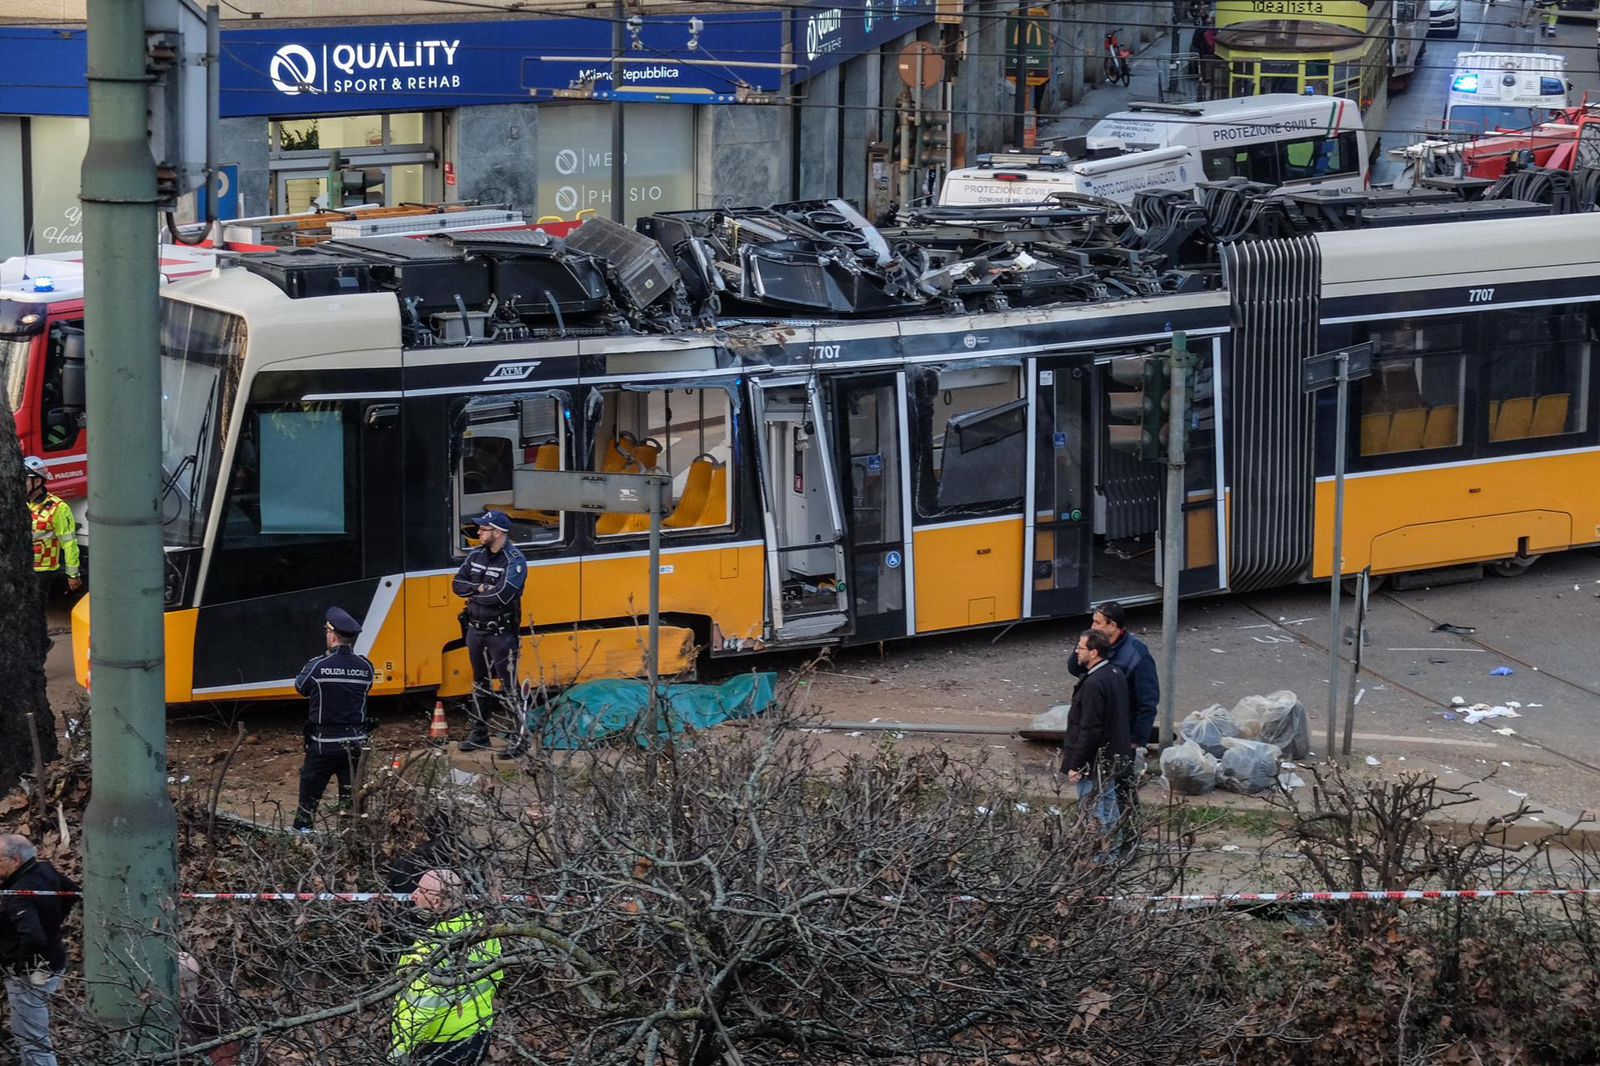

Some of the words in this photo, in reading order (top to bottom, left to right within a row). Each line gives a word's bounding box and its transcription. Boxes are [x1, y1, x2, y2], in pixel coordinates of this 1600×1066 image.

[332, 39, 461, 75] QUALITY
[333, 78, 387, 93] SPORT
[392, 78, 402, 90] &
[408, 75, 461, 89] REHAB
[1213, 122, 1282, 141] PROTEZIONE
[1284, 118, 1317, 133] CIVILE
[963, 184, 1022, 195] PROTEZIONE
[1024, 187, 1055, 196] CIVILE
[1093, 183, 1115, 197] POSTO
[1116, 176, 1146, 193] COMANDO
[1147, 171, 1177, 187] AVANZATO
[588, 186, 662, 204] PHSIO
[1469, 288, 1495, 302] 7707
[808, 344, 841, 360] 7707
[499, 366, 523, 376] ATM
[54, 469, 84, 480] MAGIRUS
[320, 667, 346, 676] POLIZIA
[346, 668, 369, 678] LOCALE
